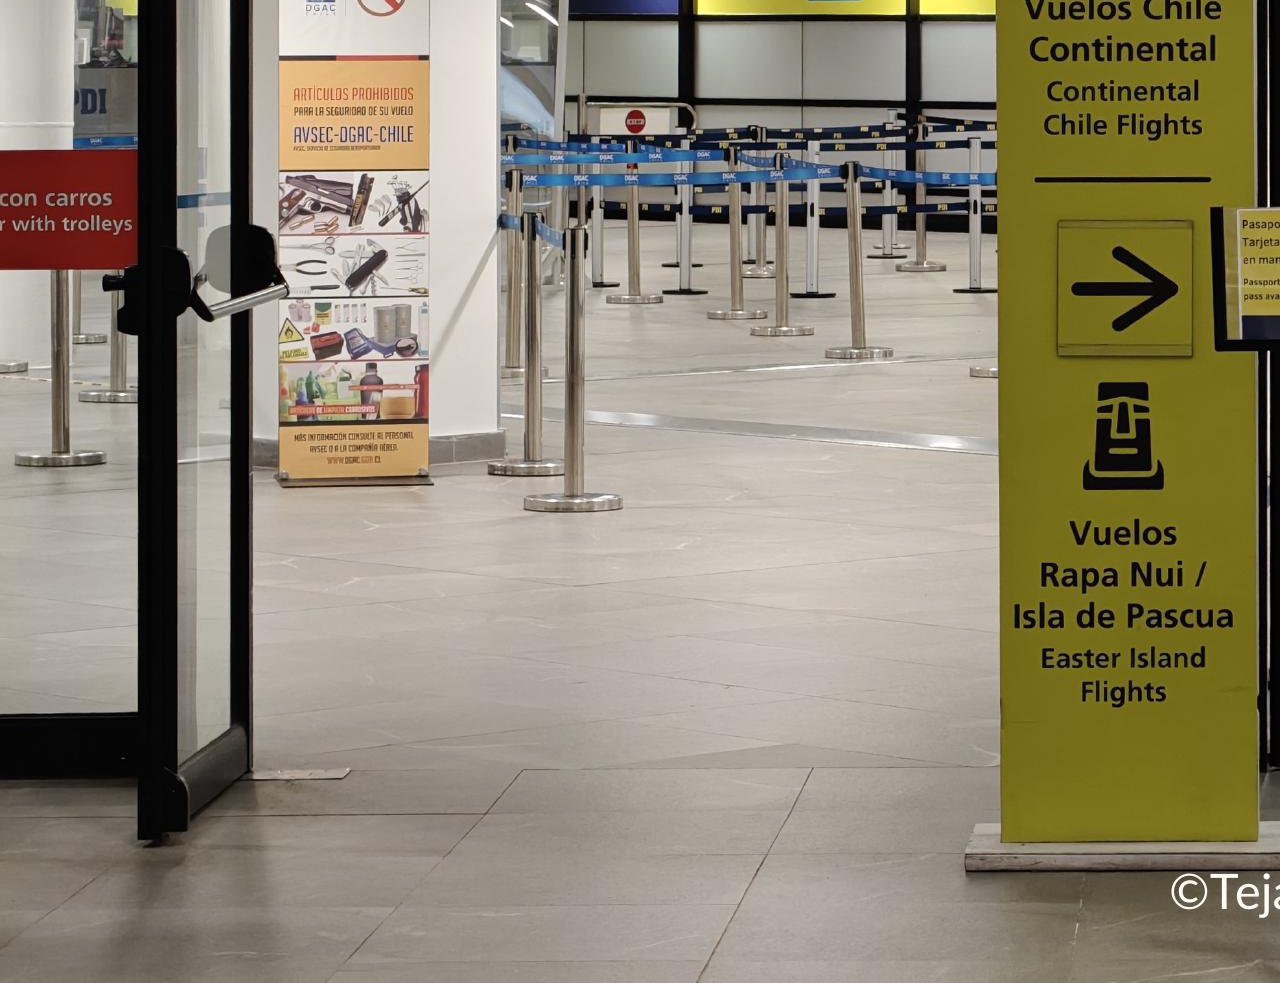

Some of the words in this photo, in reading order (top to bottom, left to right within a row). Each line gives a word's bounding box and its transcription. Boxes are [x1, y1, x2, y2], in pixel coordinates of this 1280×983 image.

[305, 4, 337, 13] DGAC
[1029, 34, 1216, 62] Continental
[351, 87, 415, 101] PROHIBIDOS
[1046, 79, 1199, 102] Continental
[294, 106, 314, 117] PARA
[314, 106, 325, 116] LA
[326, 106, 367, 117] SEGURIDAD
[368, 106, 378, 116] DE
[379, 106, 390, 116] SU
[391, 105, 414, 116] VUELO
[293, 125, 415, 144] AVSEC-DGAC-CHILE
[1043, 112, 1108, 136] Chile
[1117, 112, 1203, 142] Flights
[0, 192, 38, 207] con
[45, 192, 113, 207] carros
[11, 214, 56, 232] with
[61, 214, 133, 236] trolleys
[1241, 237, 1280, 250] Tarjeta
[1242, 256, 1256, 265] en
[1243, 293, 1264, 302] pass
[1069, 518, 1177, 546] Vuelos
[1040, 562, 1119, 595] Rapa
[1131, 560, 1183, 588] Nui
[1194, 560, 1207, 588] /
[1013, 601, 1065, 629] Isla
[1076, 601, 1116, 629] de
[1127, 602, 1234, 629] Pascua
[1041, 647, 1122, 669] Easter
[1130, 645, 1206, 669] Island
[1081, 679, 1167, 708] Flights
